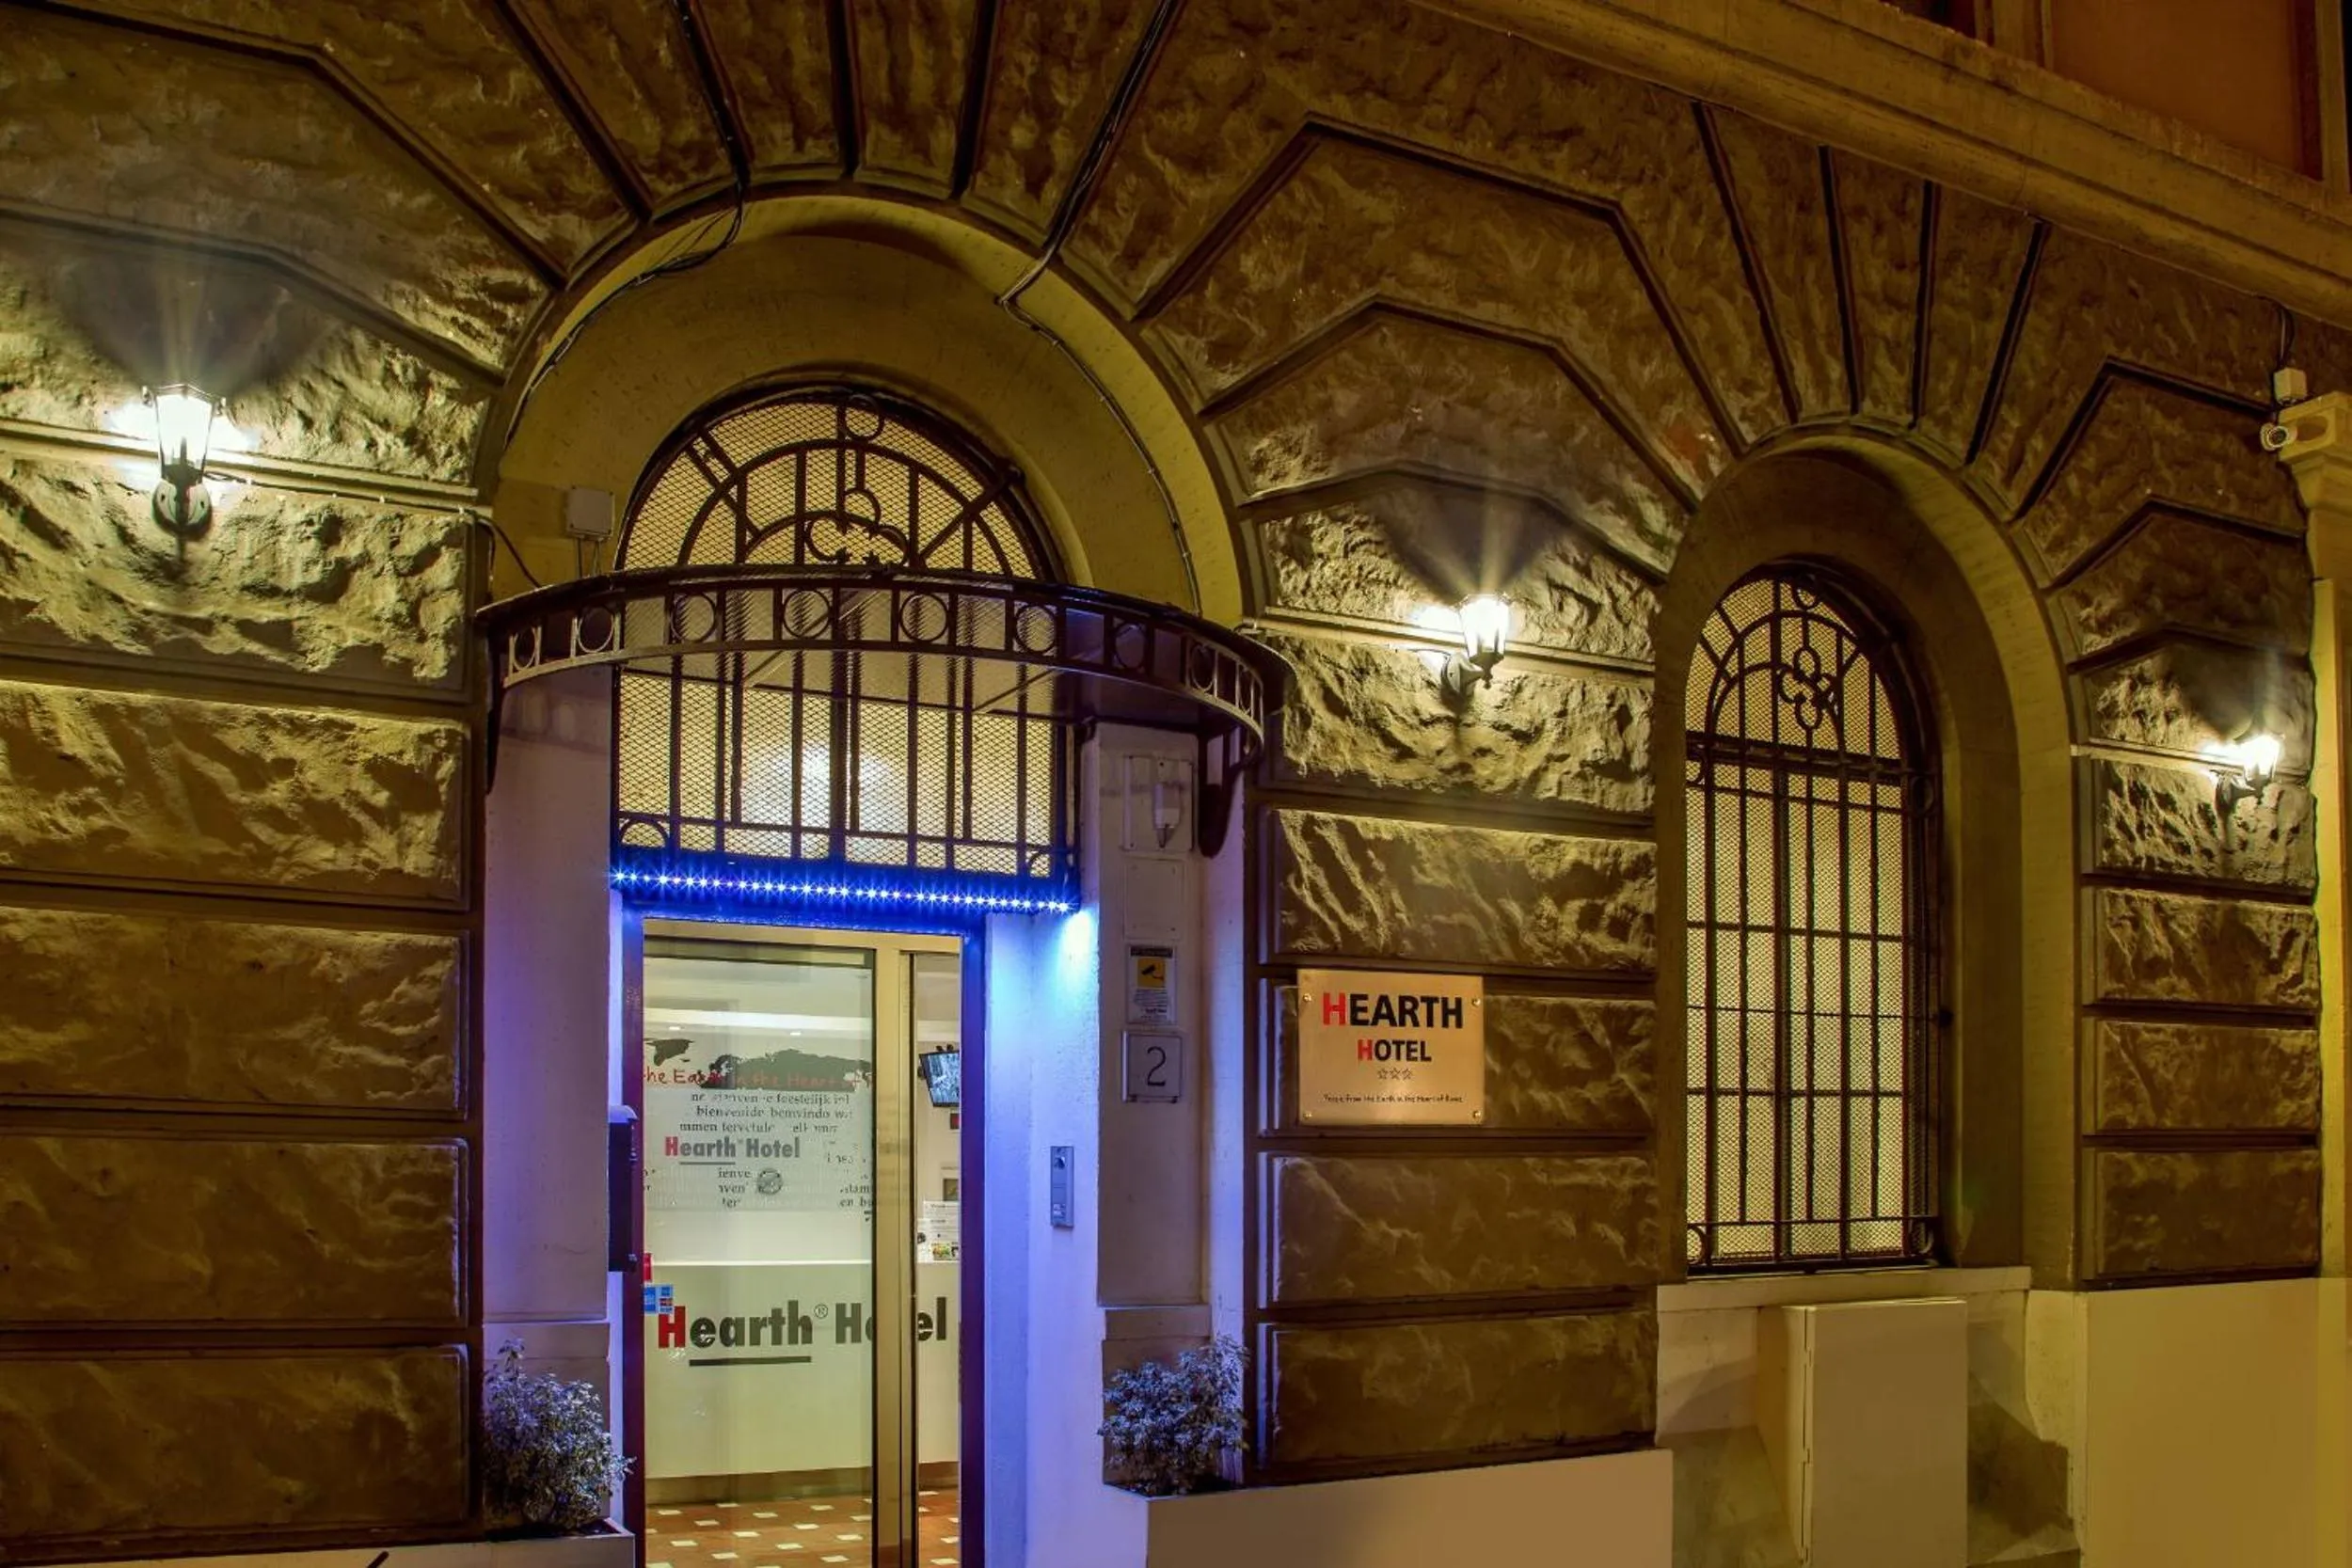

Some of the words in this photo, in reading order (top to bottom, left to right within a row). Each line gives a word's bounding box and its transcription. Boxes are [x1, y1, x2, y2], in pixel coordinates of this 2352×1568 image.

[1323, 992, 1463, 1028] HEARTH
[1358, 1039, 1432, 1062] HOTEL
[1146, 1045, 1167, 1086] 2
[746, 1137, 800, 1158] Hotel
